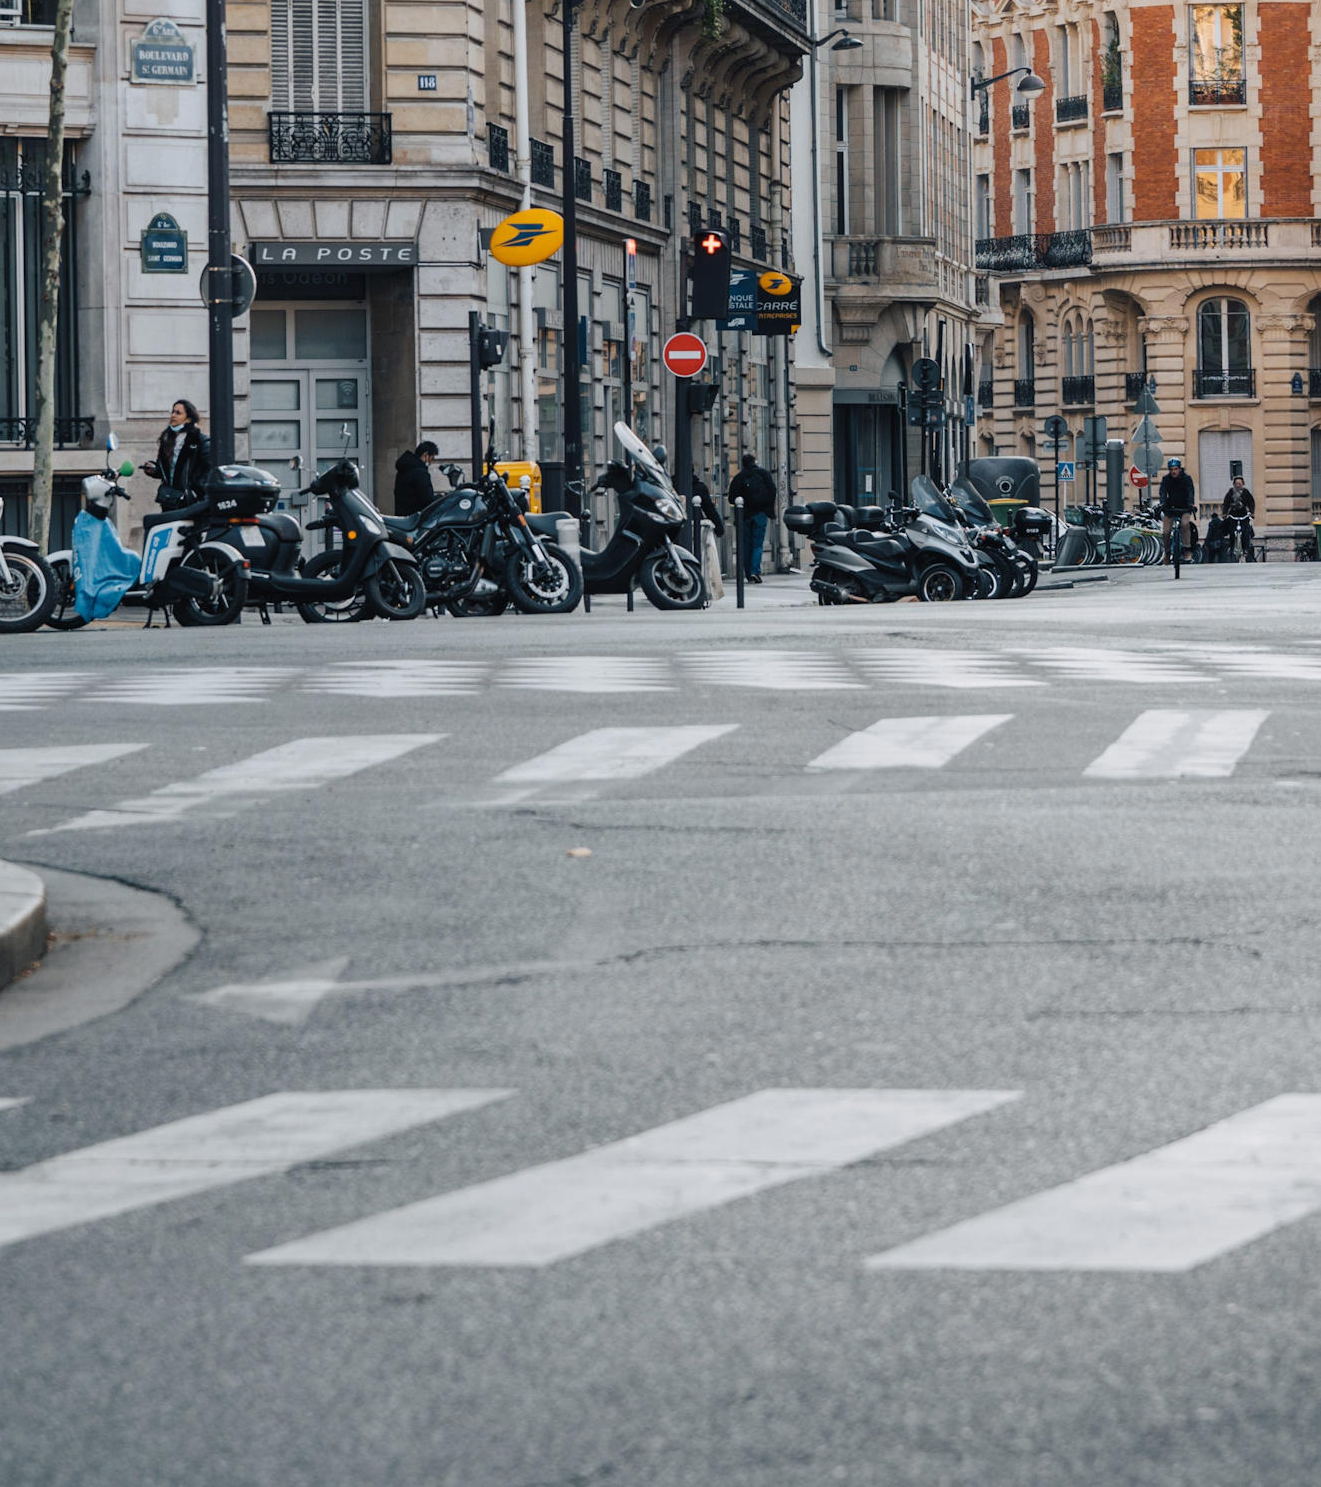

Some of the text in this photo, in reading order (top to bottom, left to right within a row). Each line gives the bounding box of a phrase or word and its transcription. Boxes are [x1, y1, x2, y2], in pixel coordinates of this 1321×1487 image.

[139, 49, 189, 62] BOULEVARD
[151, 65, 188, 76] GERMAIN
[419, 76, 436, 89] 118
[262, 248, 412, 261] LA POSTE
[757, 300, 798, 311] CARRÉ
